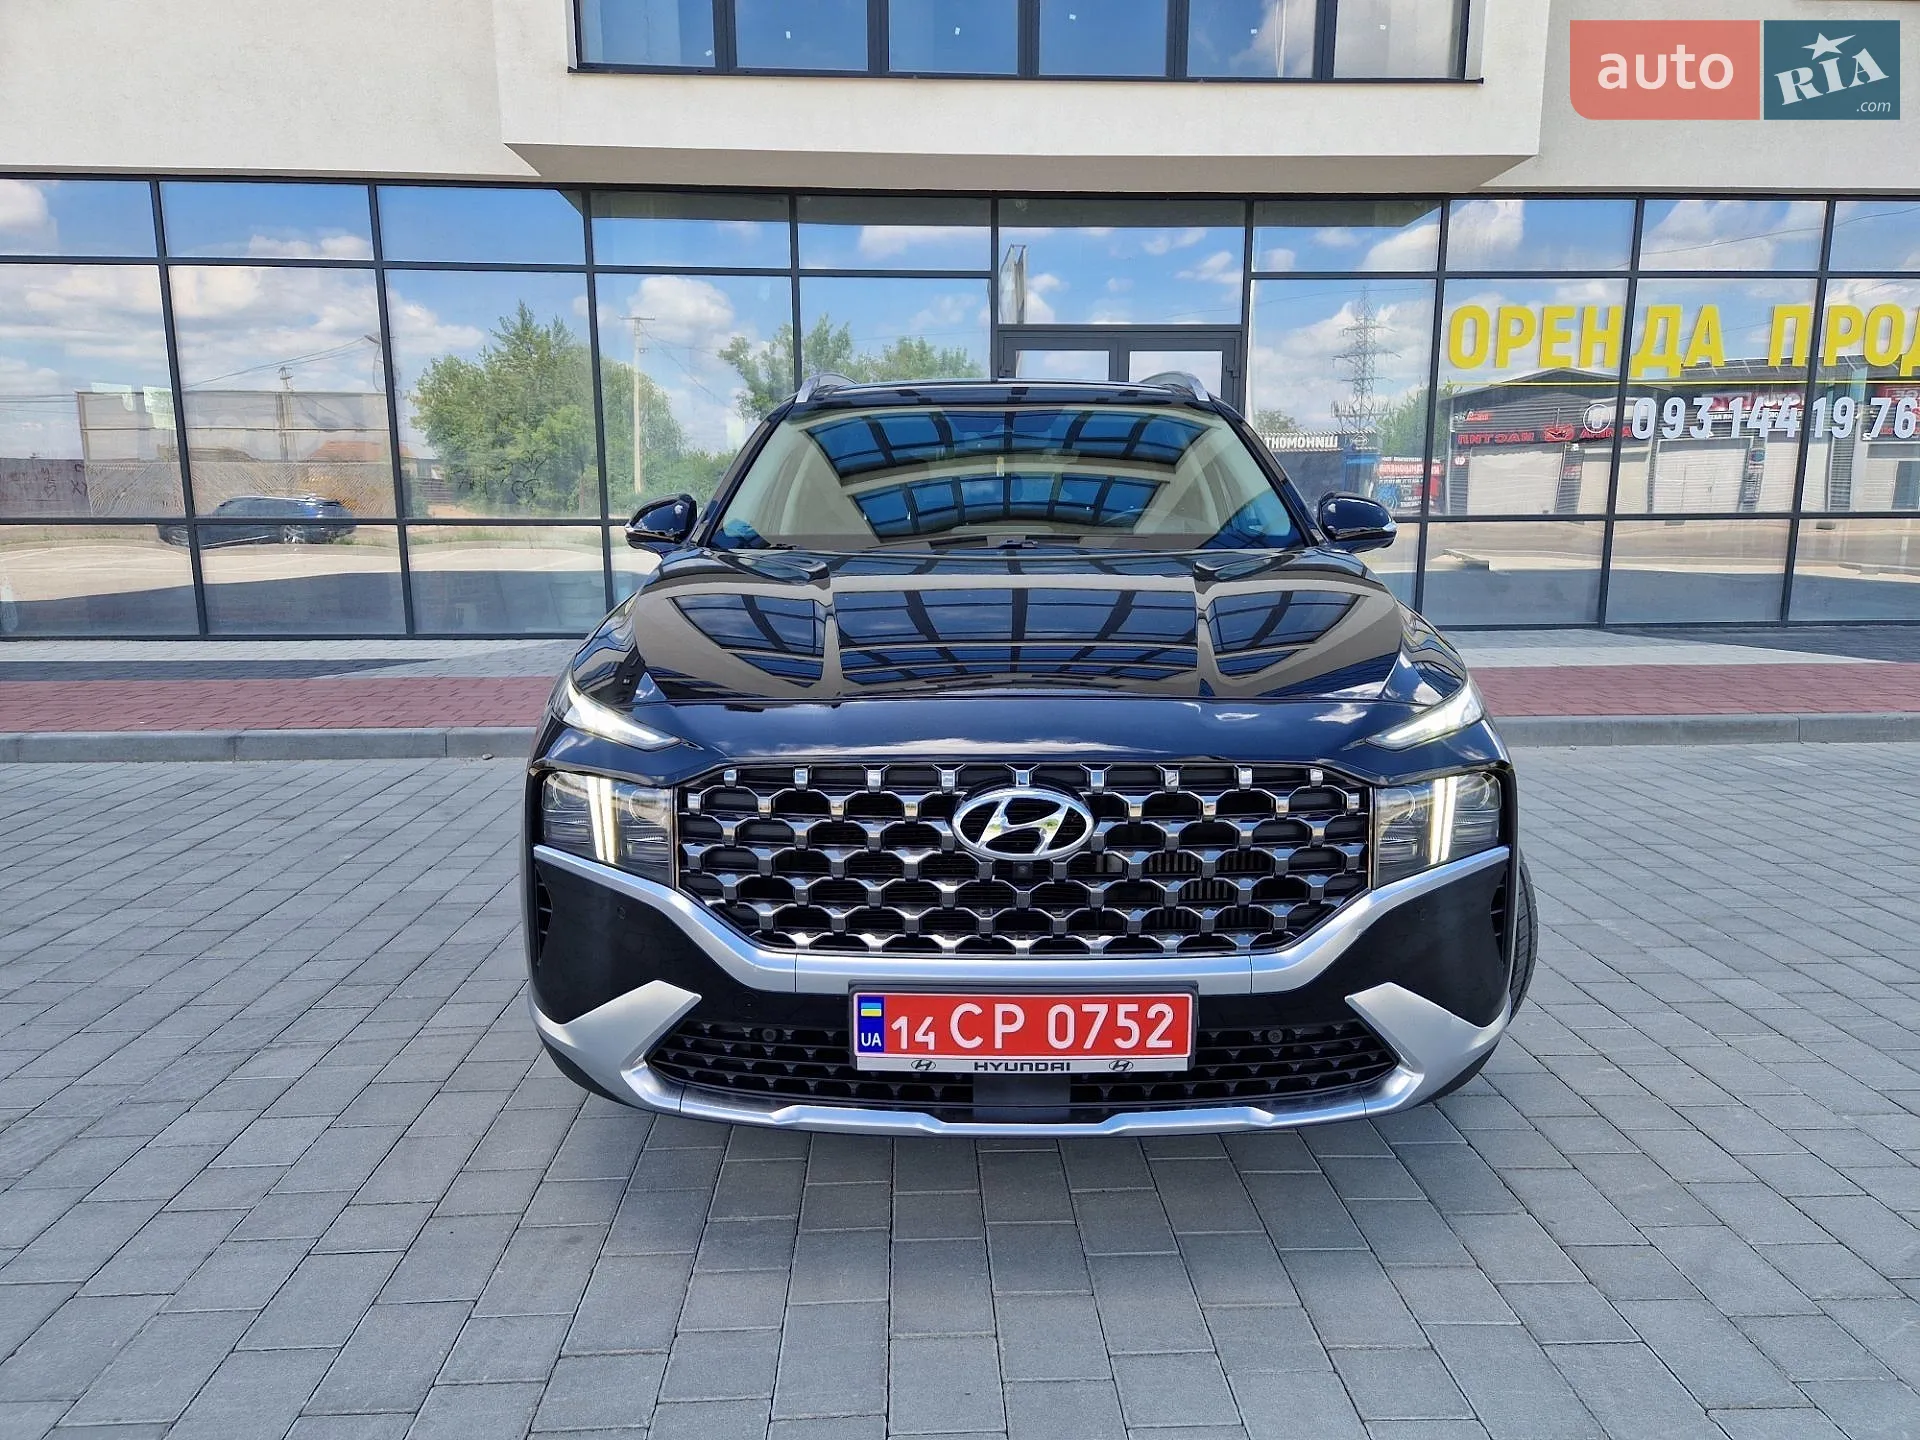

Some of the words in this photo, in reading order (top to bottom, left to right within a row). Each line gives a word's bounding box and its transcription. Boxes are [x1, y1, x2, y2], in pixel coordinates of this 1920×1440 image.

[1448, 304, 1724, 378] ОРЕНДА
[1631, 397, 1714, 439] 093
[1728, 397, 1801, 438] 144
[1812, 397, 1855, 439] 19
[1868, 397, 1917, 439] 76
[861, 1032, 882, 1047] UA
[891, 1015, 936, 1050] 14
[1048, 1003, 1174, 1050] 0752
[973, 1061, 1071, 1072] HYUNDAI
